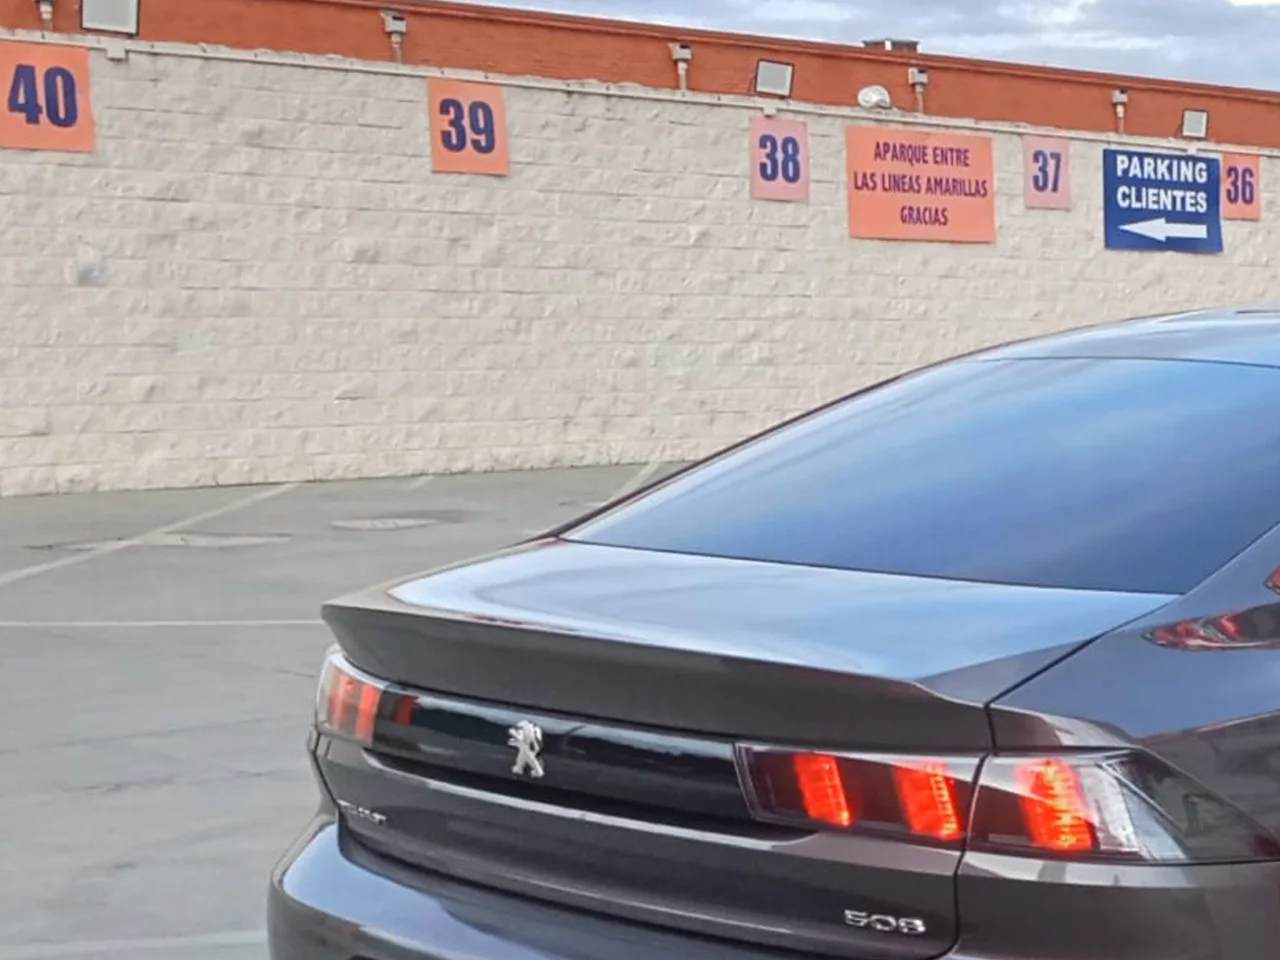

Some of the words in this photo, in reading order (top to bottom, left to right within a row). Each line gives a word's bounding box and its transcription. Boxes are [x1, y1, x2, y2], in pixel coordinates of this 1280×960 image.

[9, 64, 78, 128] 40
[440, 97, 496, 154] 39
[759, 134, 800, 184] 38
[874, 141, 928, 166] APARQUE
[933, 146, 970, 167] ENTRE
[1116, 154, 1208, 183] PARKING
[853, 171, 877, 190] LAS
[882, 173, 921, 194] LINEAS
[926, 177, 987, 197] AMARILLAS
[1032, 150, 1062, 194] 37
[1227, 166, 1255, 205] 36
[1116, 185, 1208, 213] CLIENTES
[900, 206, 948, 225] GRACIAS
[844, 909, 926, 934] 508
